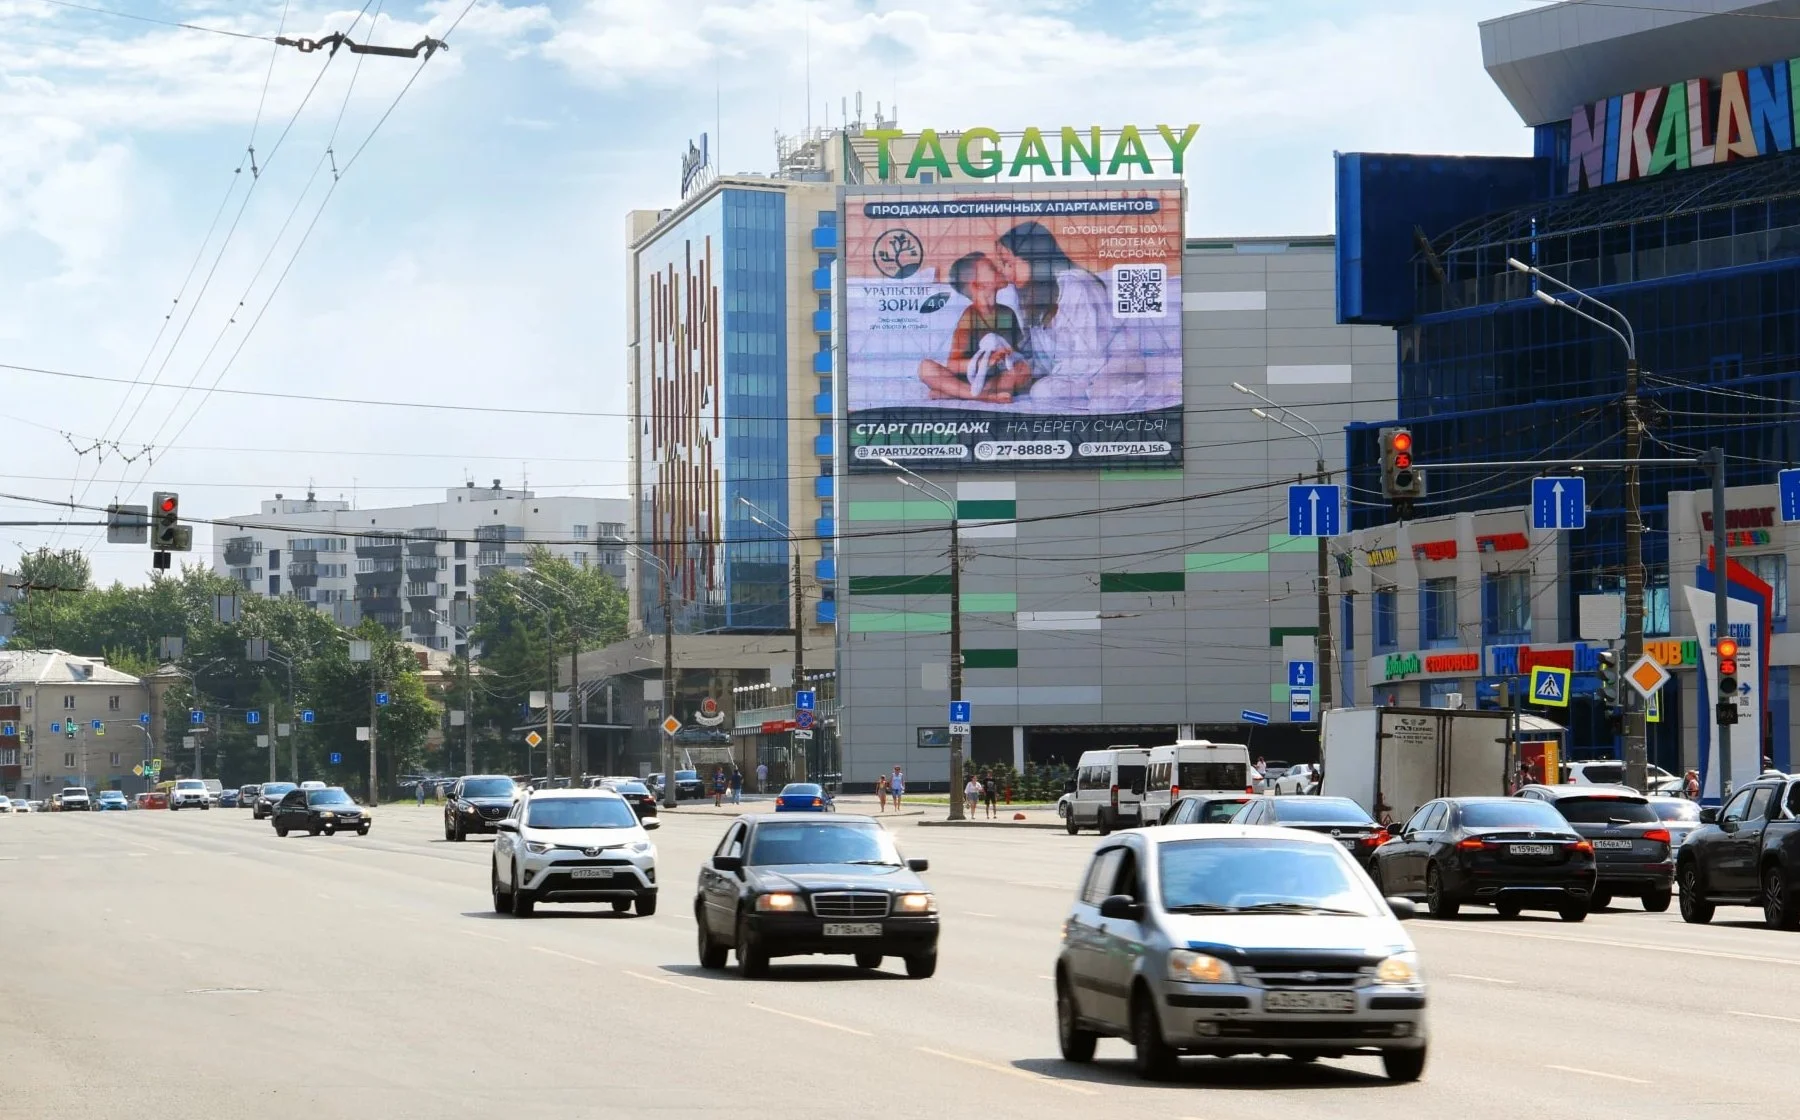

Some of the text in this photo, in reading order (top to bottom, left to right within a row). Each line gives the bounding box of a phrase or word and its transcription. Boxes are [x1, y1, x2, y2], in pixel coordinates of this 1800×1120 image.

[863, 124, 1201, 179] TAGANAY
[872, 200, 1154, 217] ПРОДАЖА ГОСТИНИЧНЫХ АПАРТАМЕНТОВ
[1062, 224, 1167, 235] ГОТОВНОСТЬ 100%
[1101, 236, 1167, 247] ИПОТЕКА И
[1098, 249, 1167, 259] РАССРОЧКА
[863, 287, 932, 297] УРАЛЬСКИЕ
[878, 299, 919, 312] ЗОРИ
[856, 422, 990, 435] СТАРТ ПРОДАЖ!
[1006, 419, 1168, 433] НА БЕРЕГУ СЧАСТЬЯ!
[996, 444, 1066, 456] 27-8888-3
[1094, 444, 1145, 454] УЛ.ТРУДА
